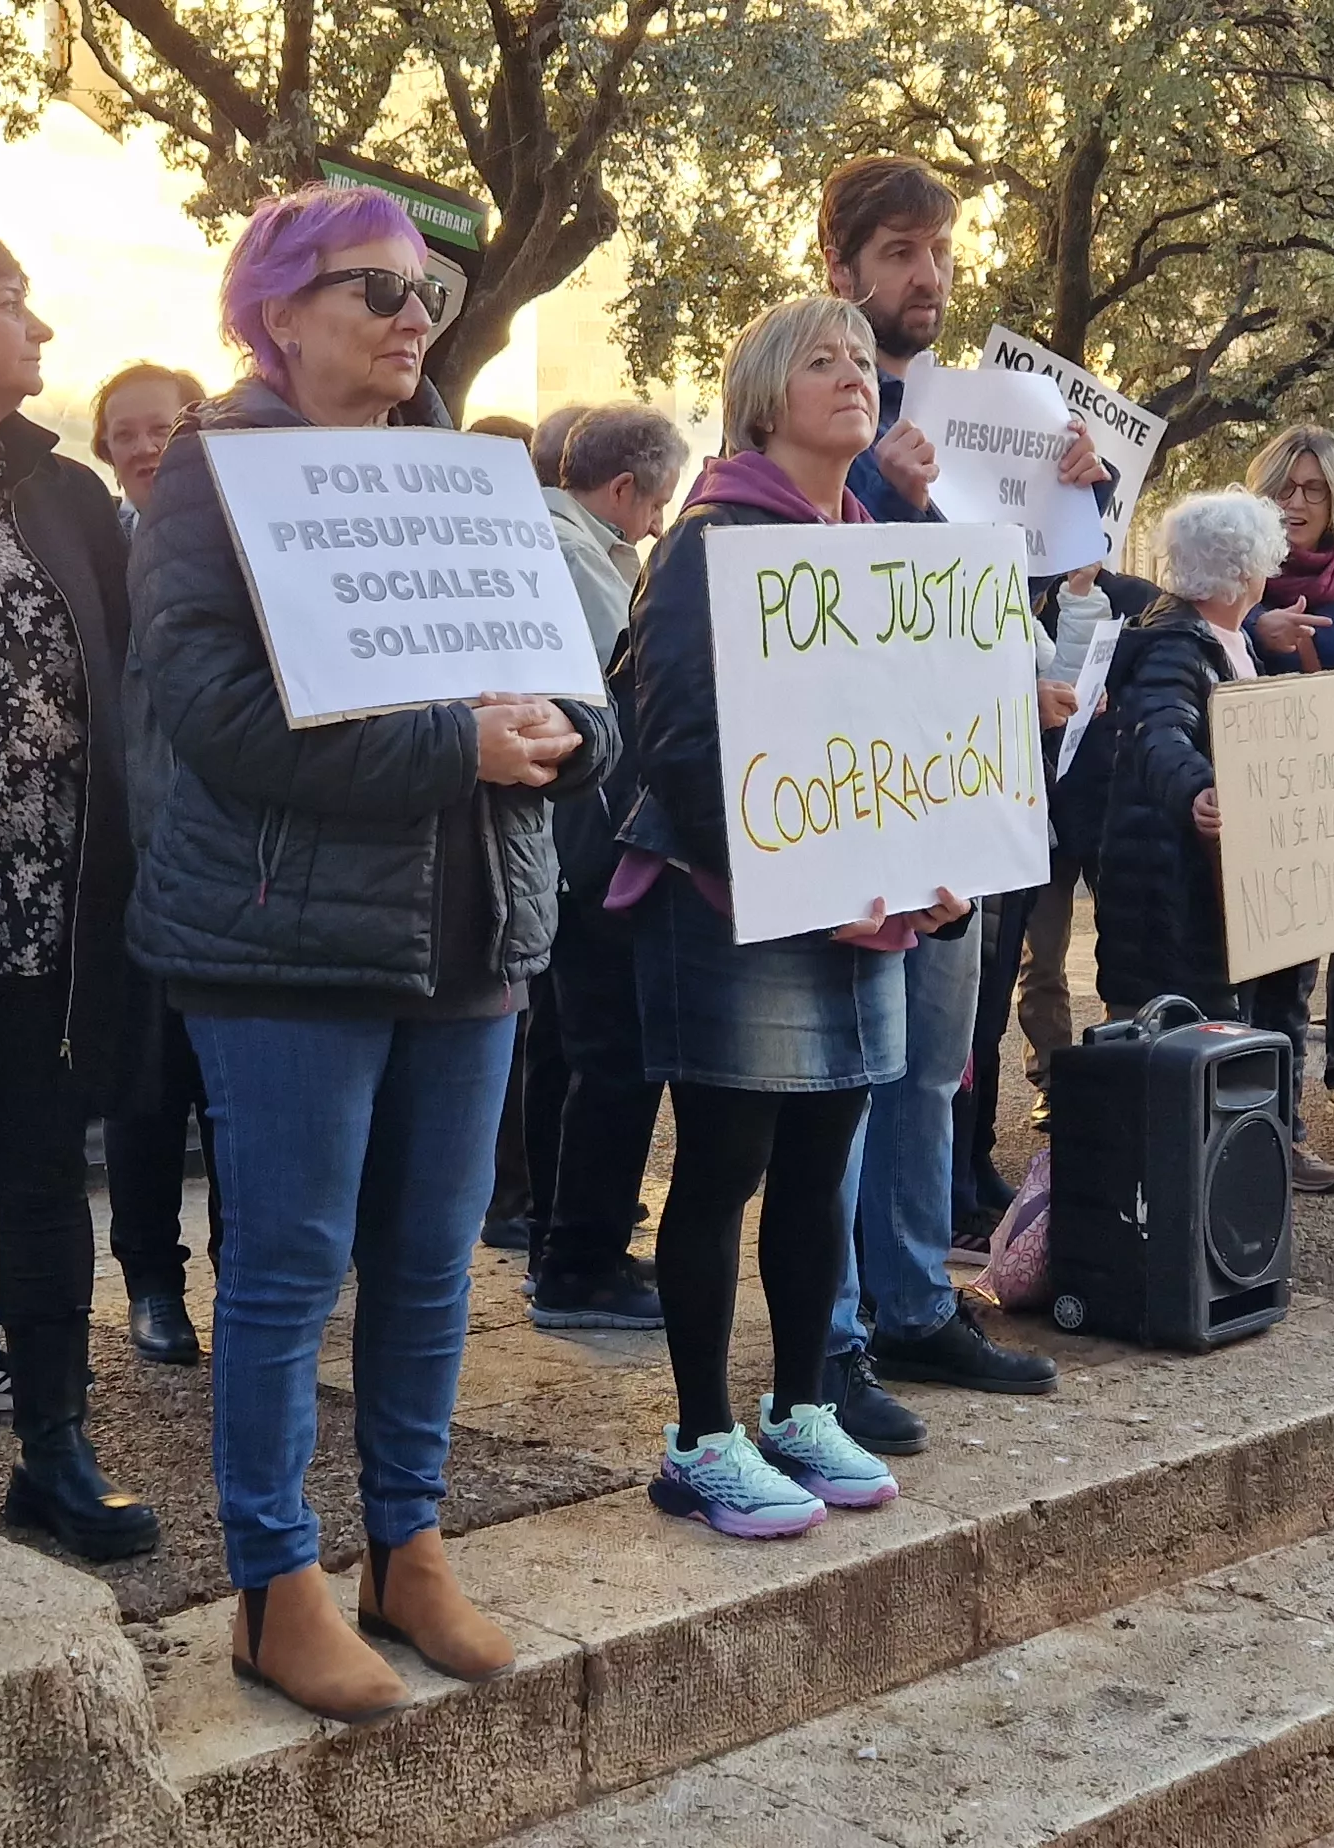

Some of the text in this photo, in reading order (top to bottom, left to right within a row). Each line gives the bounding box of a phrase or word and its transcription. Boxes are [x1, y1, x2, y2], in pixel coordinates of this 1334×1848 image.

[412, 201, 472, 235] ENTERRAR!
[994, 341, 1034, 372] NO
[1068, 378, 1151, 447] RECORTE
[302, 463, 494, 497] POR UNOS
[999, 477, 1027, 507] SIN
[267, 517, 556, 552] PRESUPUESTOS
[332, 569, 540, 605] SOCIALES Y
[757, 557, 1029, 658] POR JUSTICIA
[347, 620, 564, 659] SOLIDARIOS
[1222, 694, 1319, 744] PERIFERIAS
[1246, 761, 1269, 798] NI
[1277, 756, 1299, 800] SE
[1269, 813, 1285, 849] NI
[1292, 807, 1309, 846] SE
[1240, 867, 1270, 951] NI
[1274, 866, 1306, 937] SE
